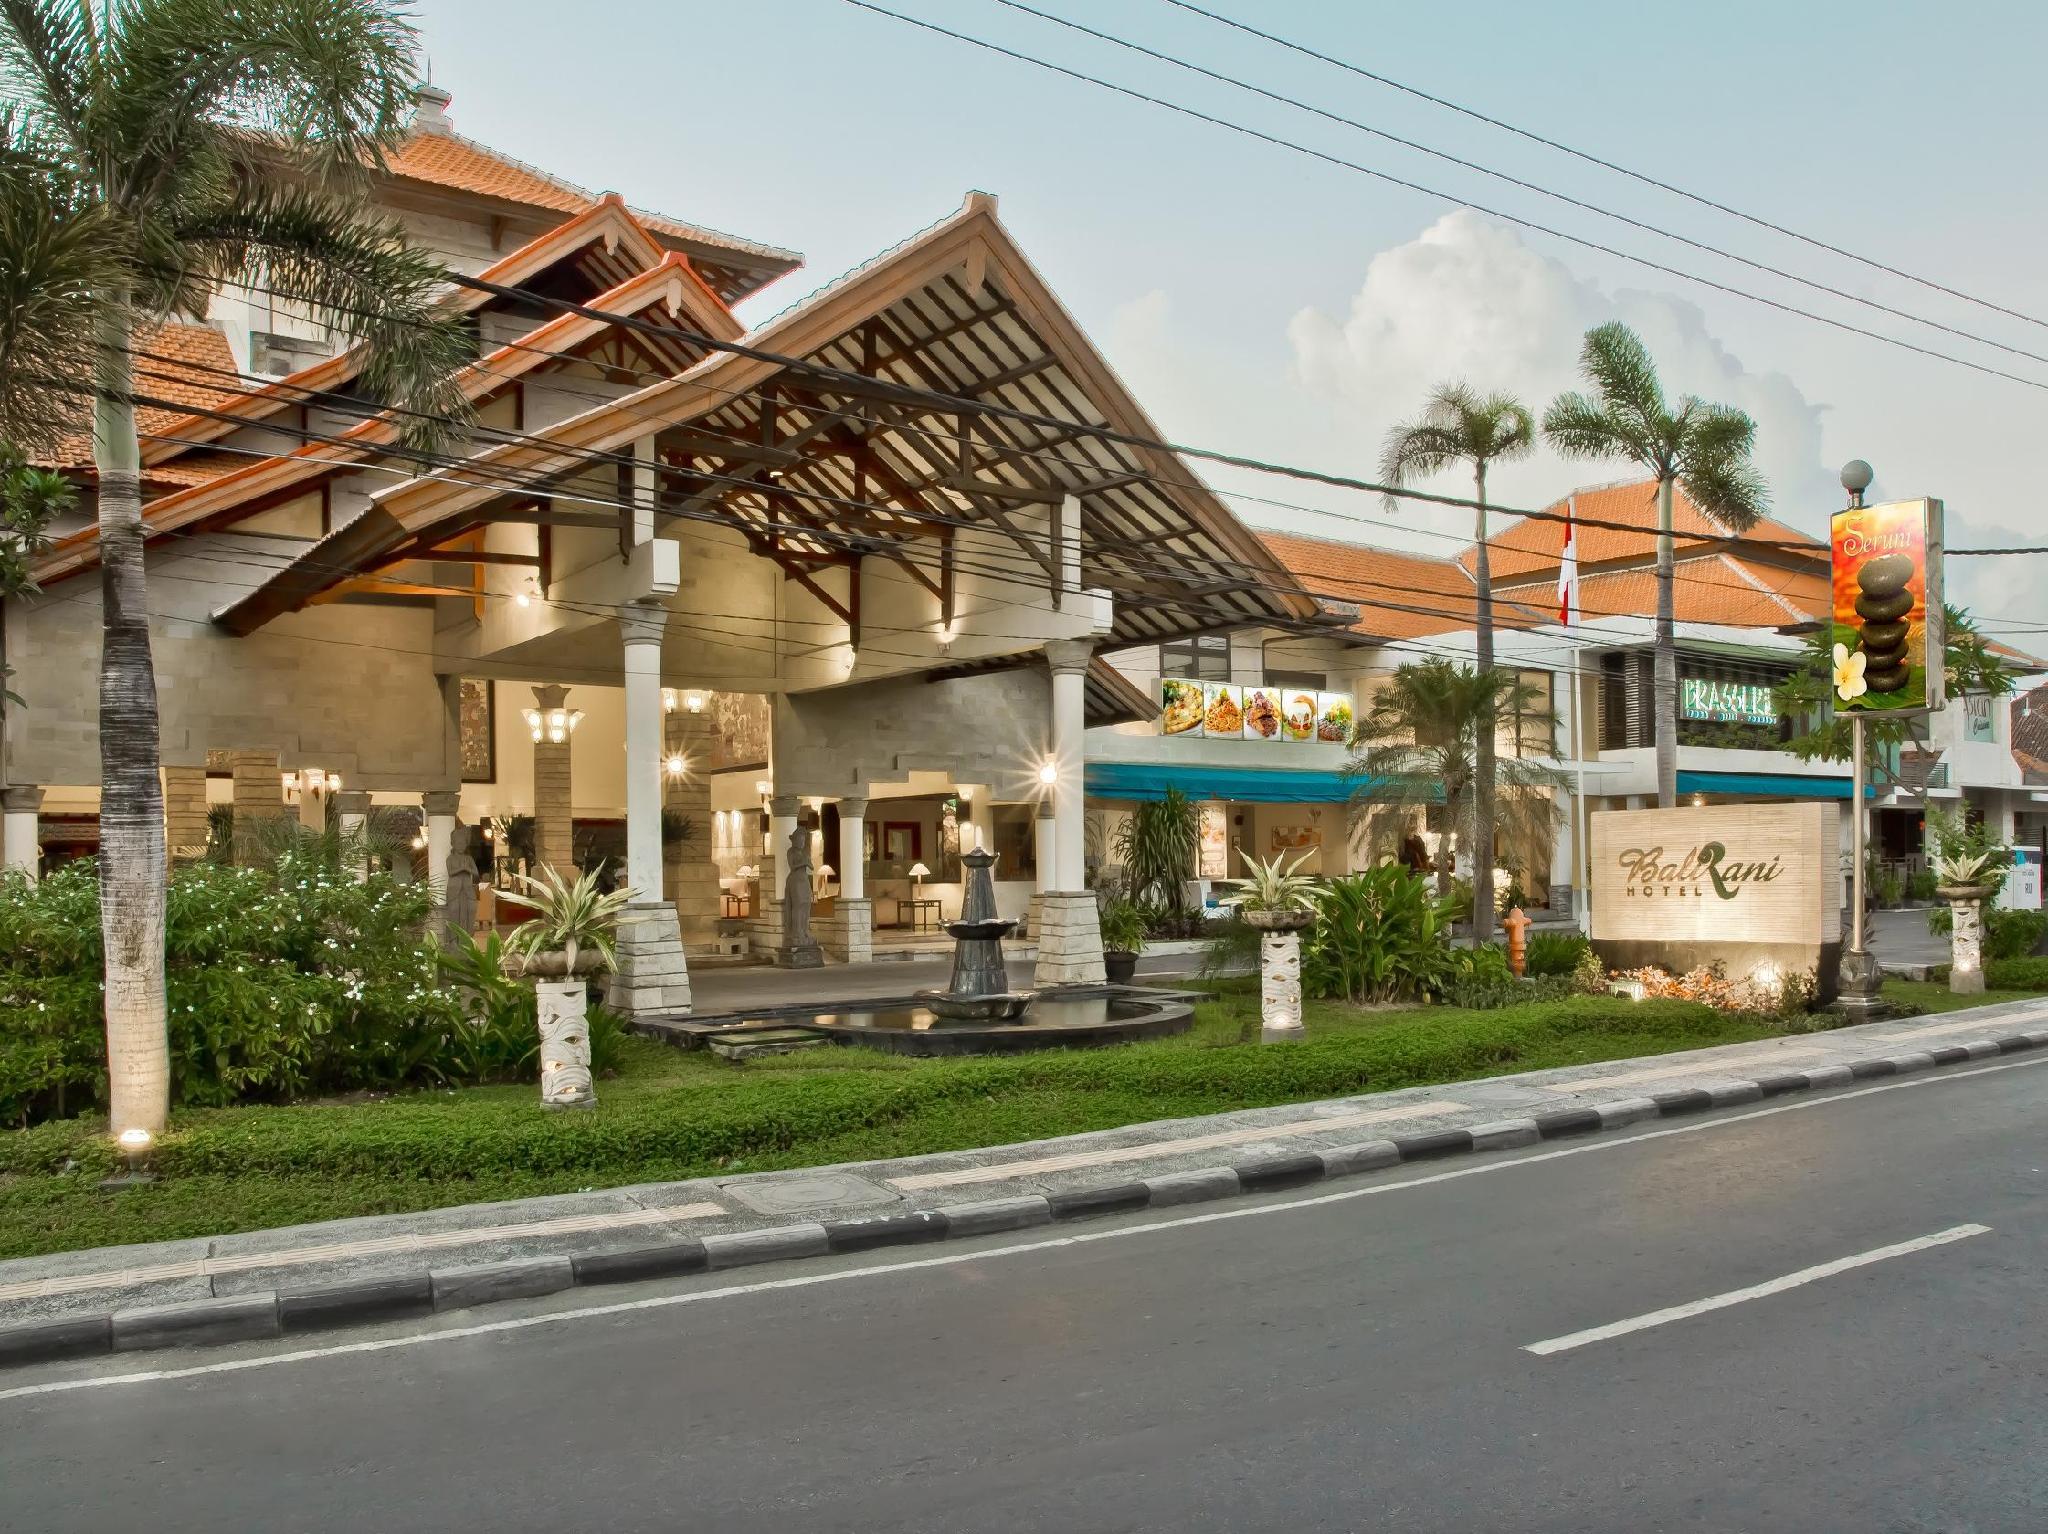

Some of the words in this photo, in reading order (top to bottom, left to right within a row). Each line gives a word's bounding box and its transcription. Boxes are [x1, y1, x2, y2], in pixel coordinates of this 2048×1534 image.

[1844, 516, 1912, 557] Seruni
[1618, 846, 1707, 883] Bali
[1697, 841, 1785, 900] Rani
[1627, 885, 1702, 897] HOTEL
